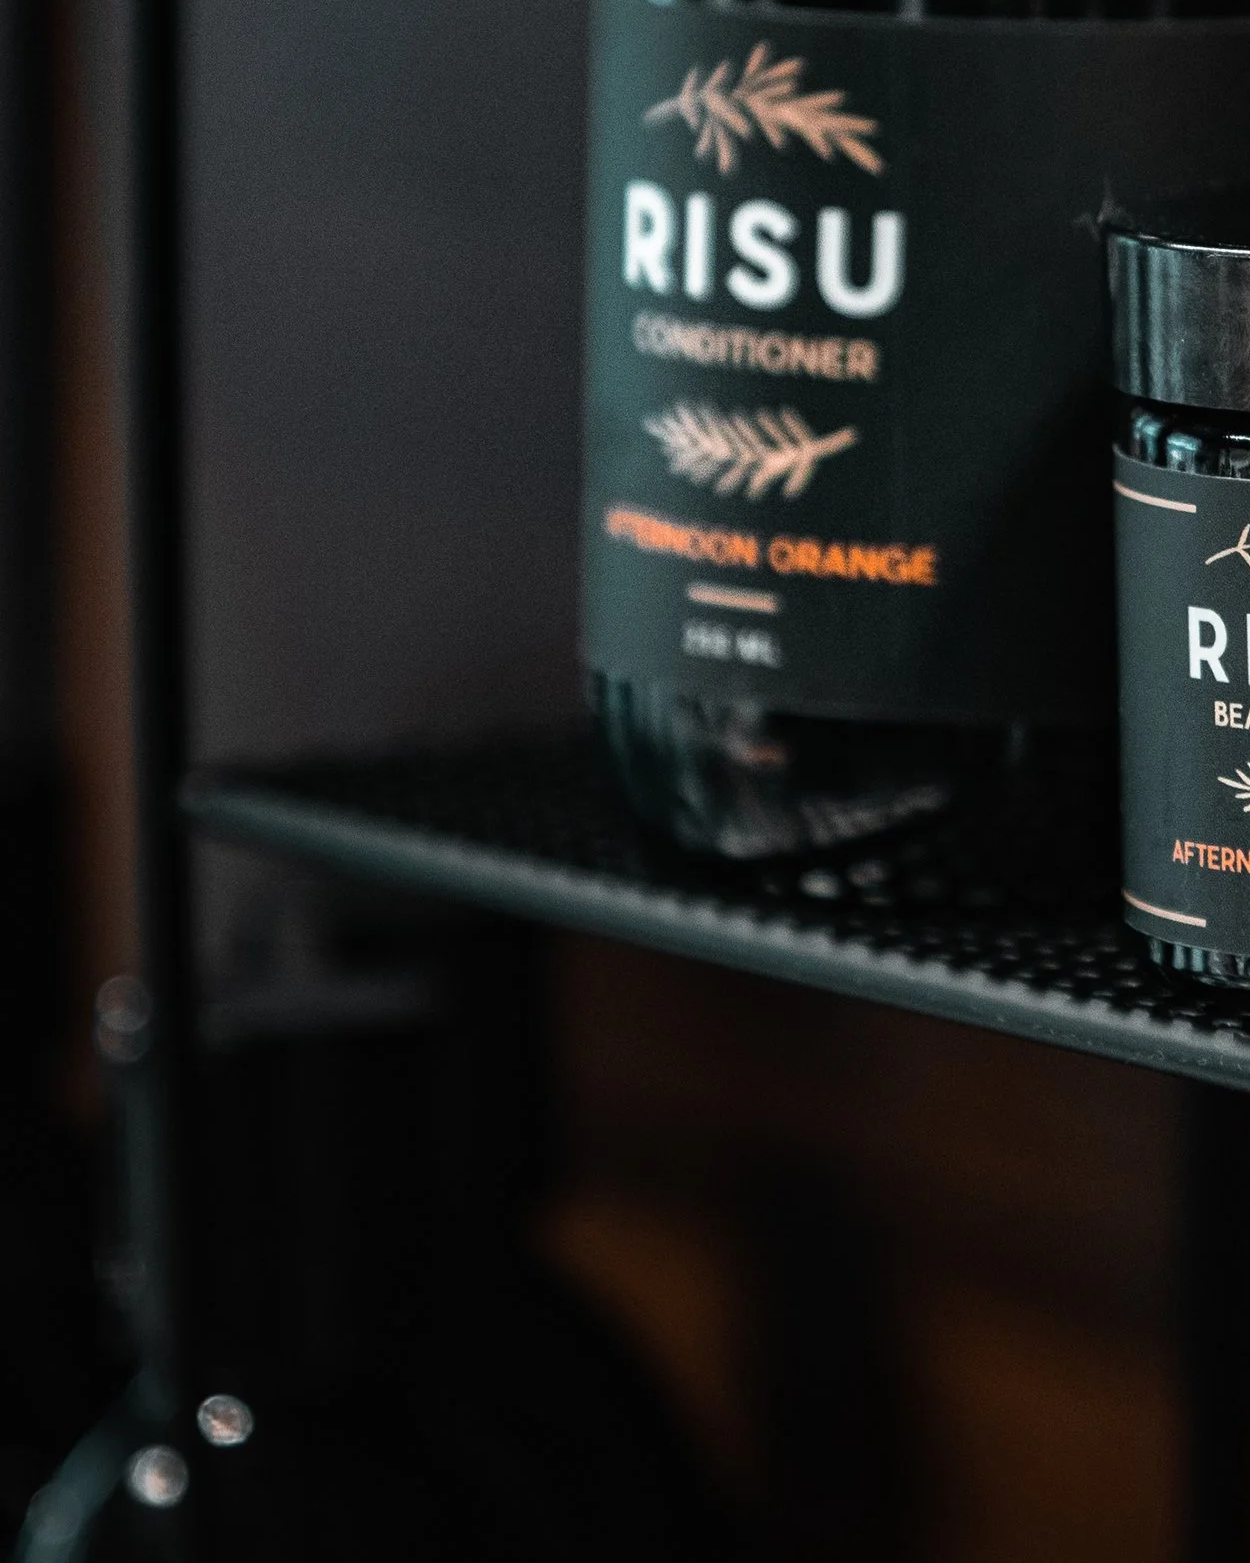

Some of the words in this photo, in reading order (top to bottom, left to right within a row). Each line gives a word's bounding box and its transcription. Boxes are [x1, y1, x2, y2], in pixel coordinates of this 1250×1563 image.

[622, 181, 907, 319] RISU
[634, 312, 880, 383] CONDITIONER
[606, 504, 760, 568] ERNOON
[767, 535, 938, 586] ORANGE
